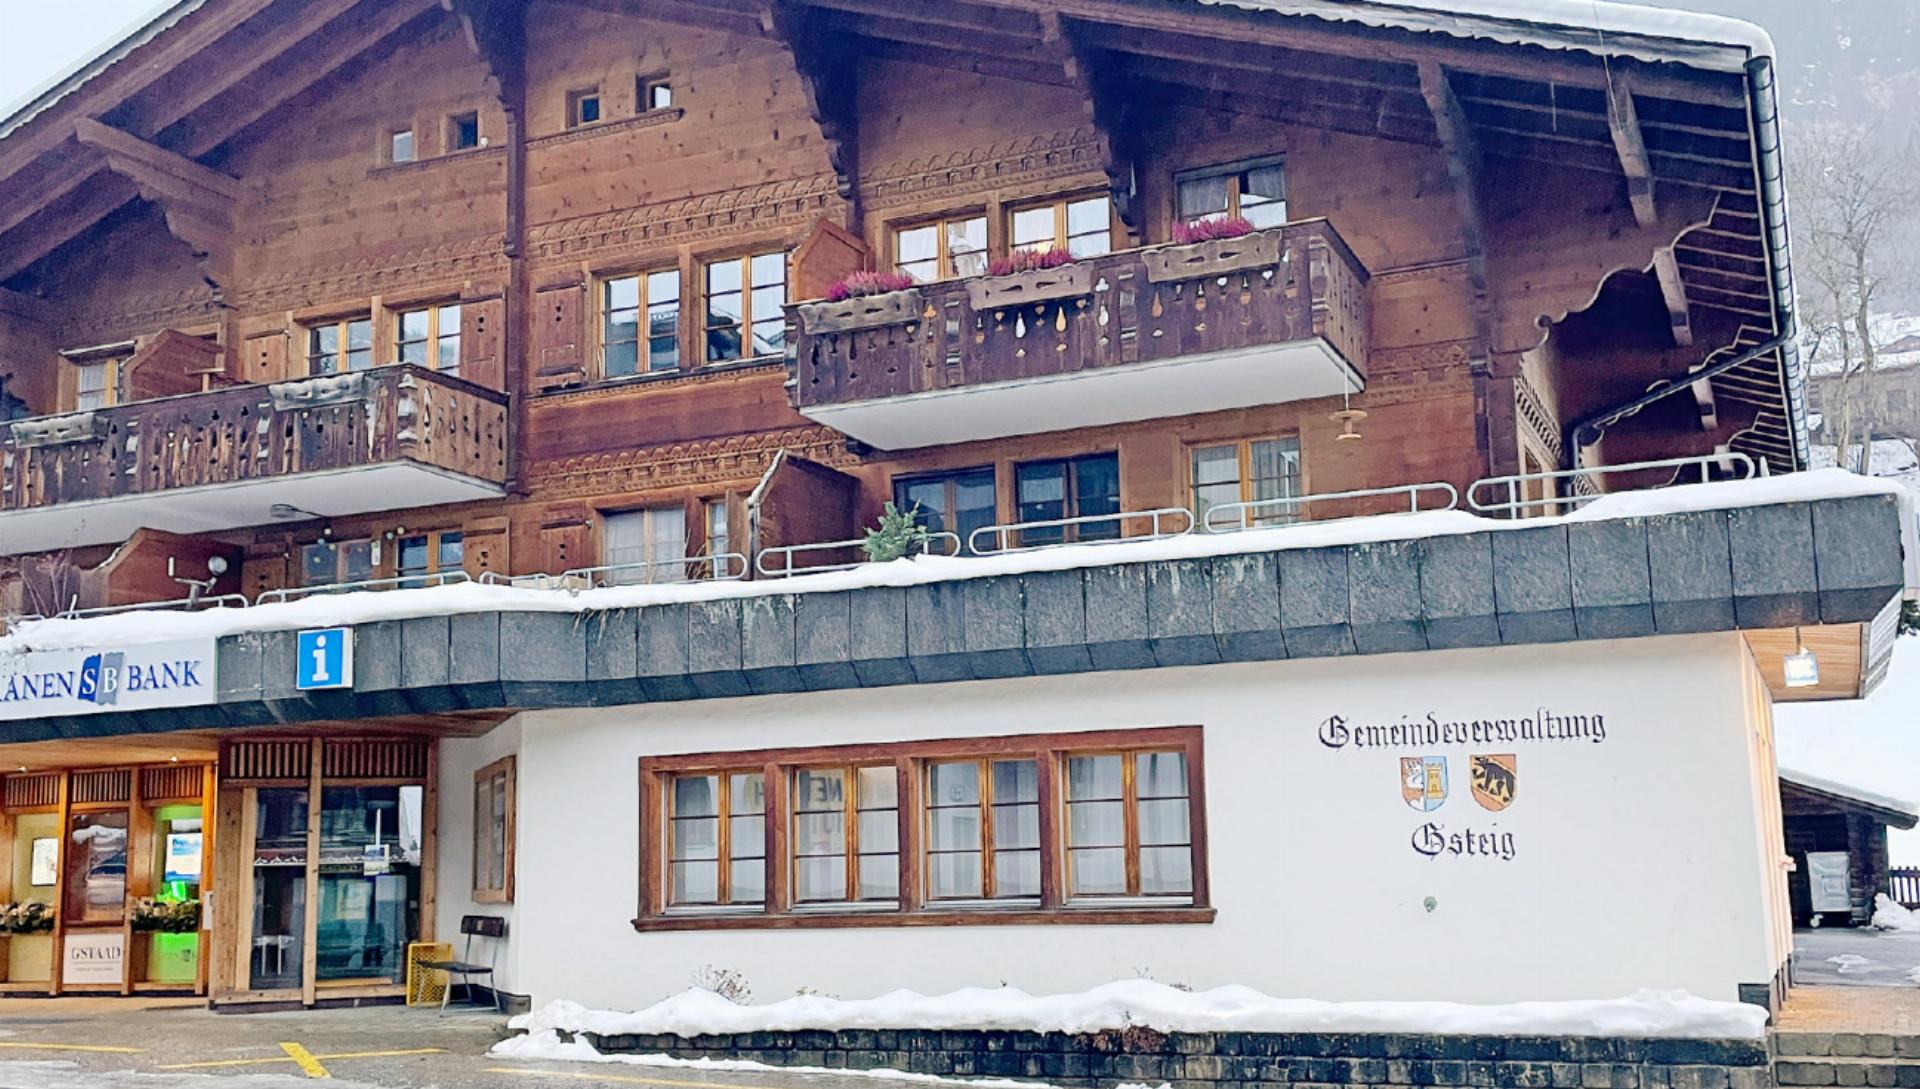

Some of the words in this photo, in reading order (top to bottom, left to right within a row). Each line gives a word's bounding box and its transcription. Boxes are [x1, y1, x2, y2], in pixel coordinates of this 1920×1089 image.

[0, 671, 75, 702] ANEN
[127, 660, 202, 692] BANK
[1318, 706, 1607, 751] Gemeindeverwaltung
[1411, 822, 1516, 861] Gsteig
[71, 946, 121, 960] GSTAAD
